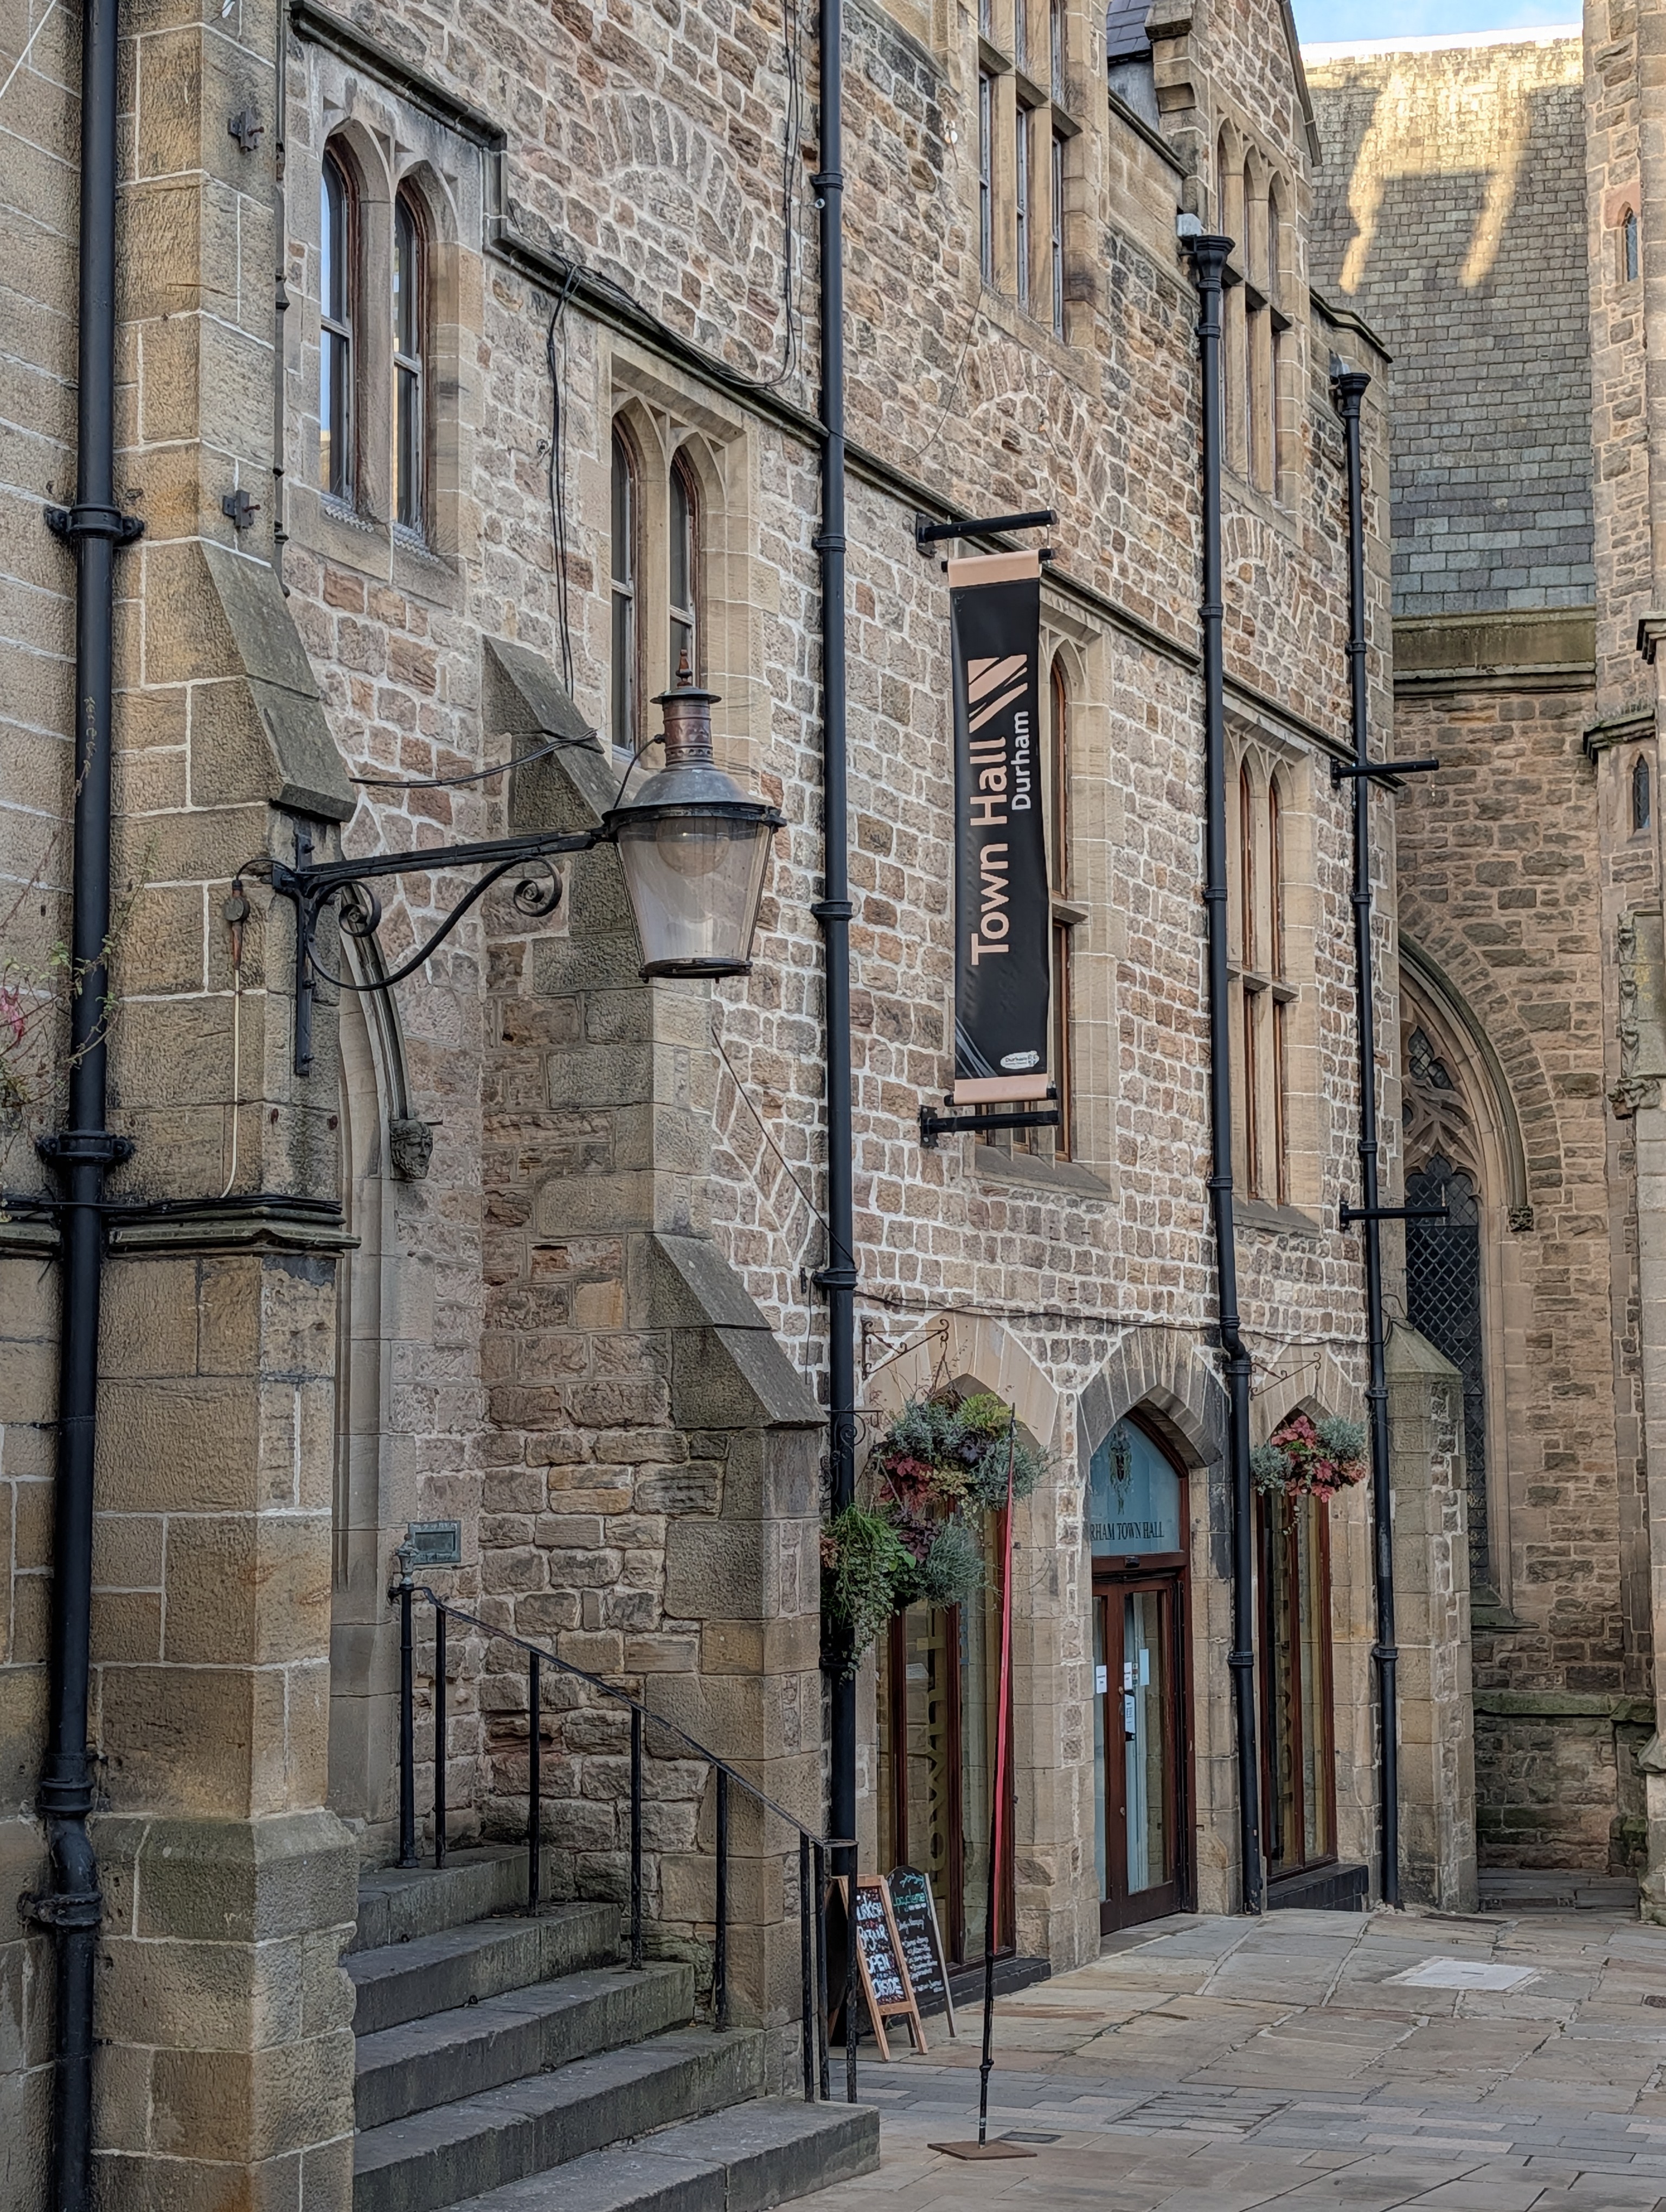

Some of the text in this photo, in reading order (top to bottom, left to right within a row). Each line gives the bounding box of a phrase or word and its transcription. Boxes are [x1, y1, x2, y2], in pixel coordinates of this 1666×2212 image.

[1010, 711, 1031, 811] Durham
[969, 736, 1009, 966] Town Hall
[1090, 1521, 1165, 1541] RHAM TOWN HALL
[866, 1953, 891, 1973] OPEN
